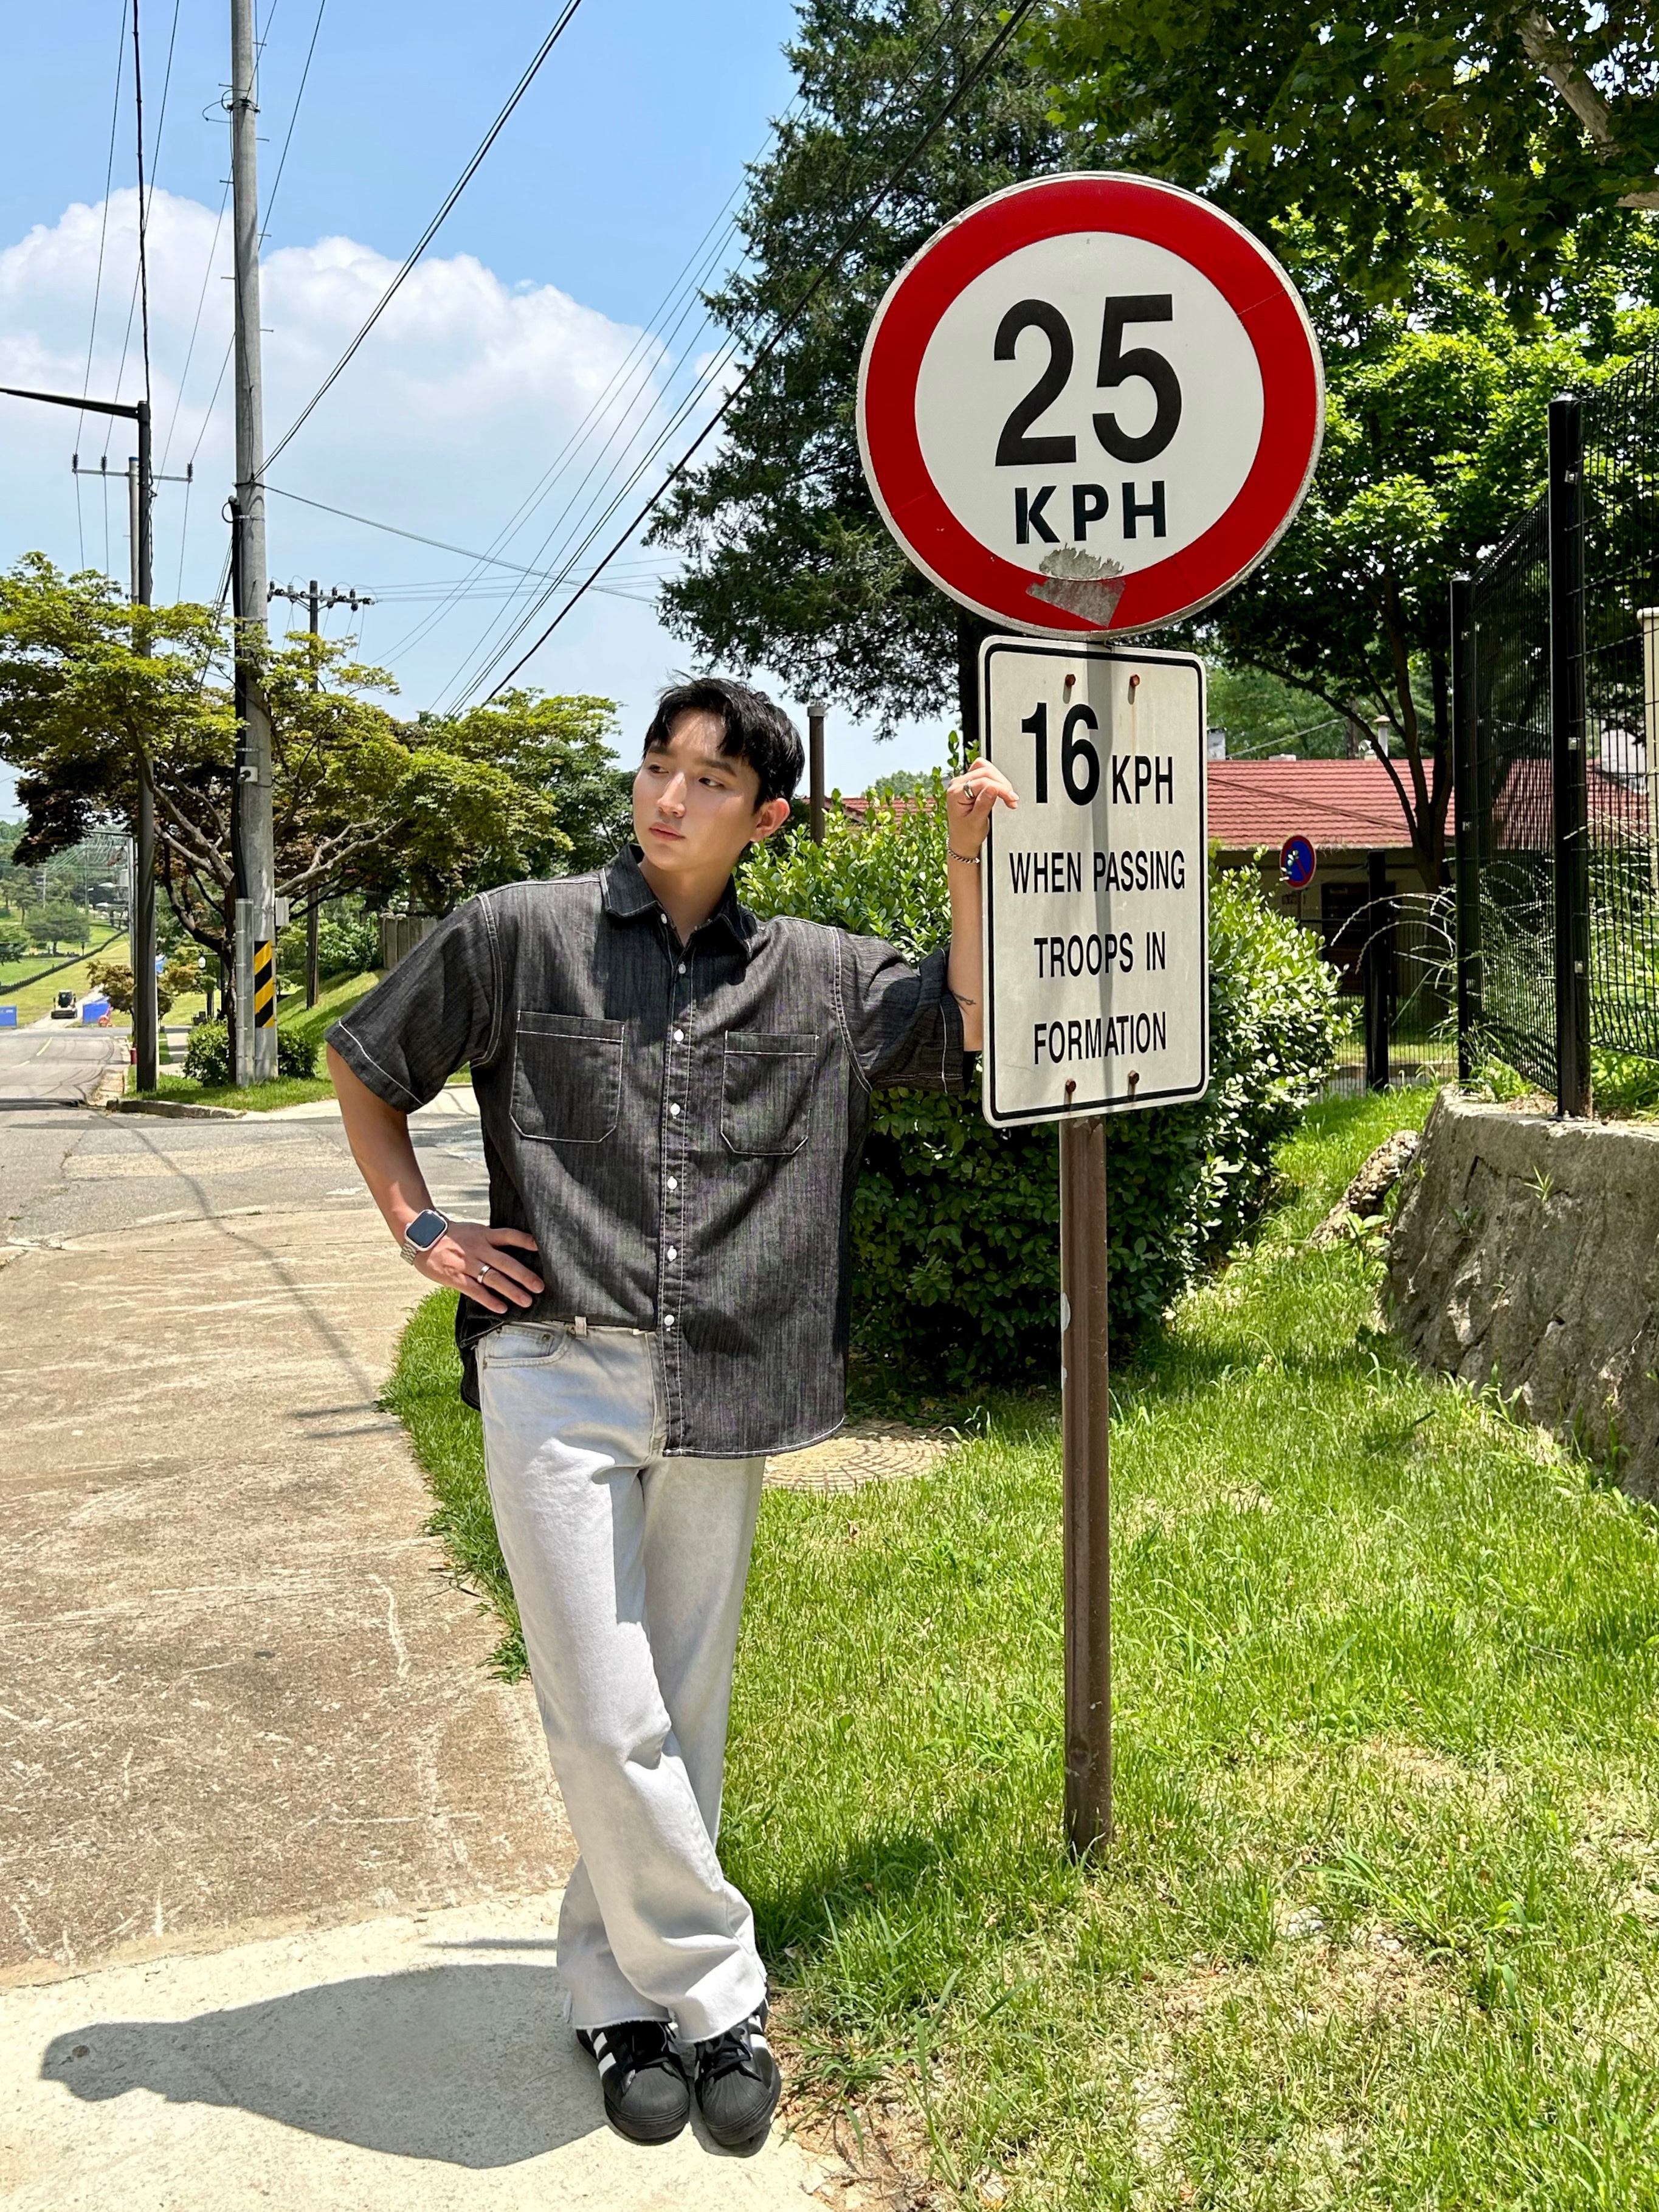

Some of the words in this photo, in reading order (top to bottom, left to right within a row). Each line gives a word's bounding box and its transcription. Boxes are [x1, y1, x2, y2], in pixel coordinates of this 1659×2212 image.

[993, 294, 1182, 467] 25
[1015, 480, 1167, 545] KPH
[1021, 702, 1101, 806] 16
[1112, 755, 1173, 804] KPH
[1009, 851, 1081, 894] WHEN
[1093, 849, 1185, 892] PASSING
[1033, 932, 1133, 978] TROOPS
[1147, 931, 1165, 971] IN
[1034, 1011, 1166, 1065] FORMATION
